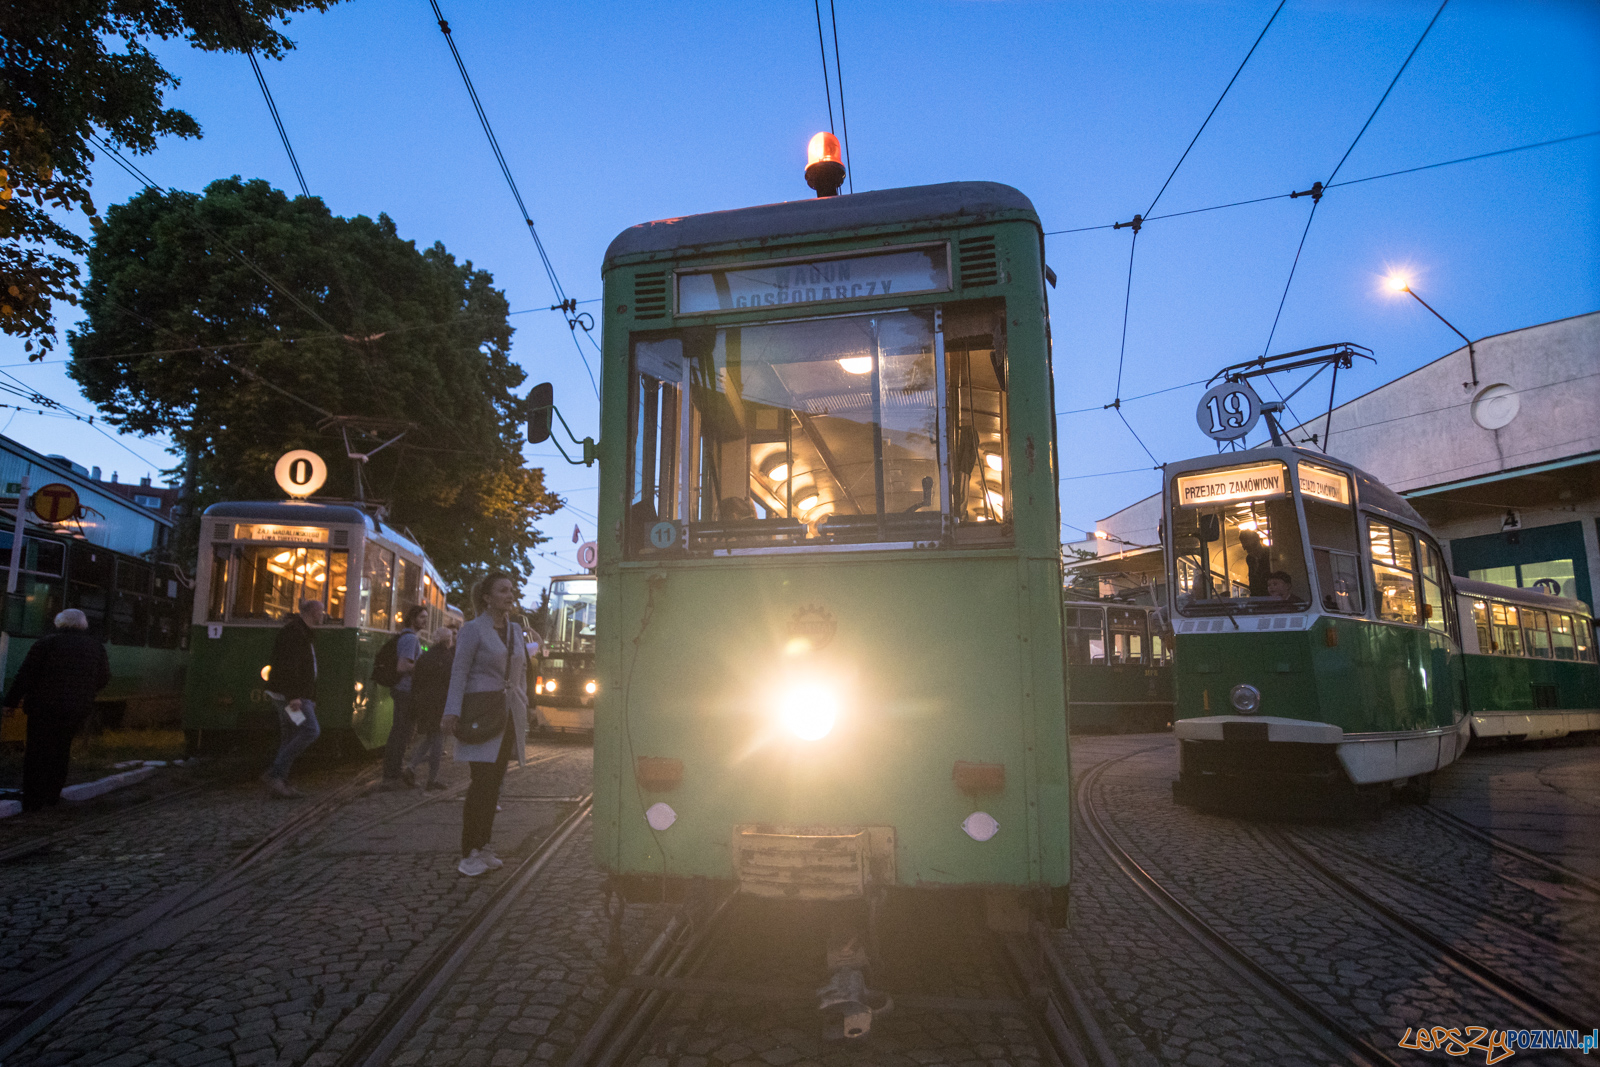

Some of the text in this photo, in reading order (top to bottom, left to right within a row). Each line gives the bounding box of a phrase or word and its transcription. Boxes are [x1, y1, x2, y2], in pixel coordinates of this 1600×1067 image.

[736, 280, 892, 308] GOSPODARCZY
[1206, 391, 1252, 433] 19
[1185, 475, 1280, 500] PRZEJAZD ZAMÓWIONY
[1504, 510, 1518, 528] 4
[654, 527, 671, 543] 11
[212, 627, 219, 636] 1
